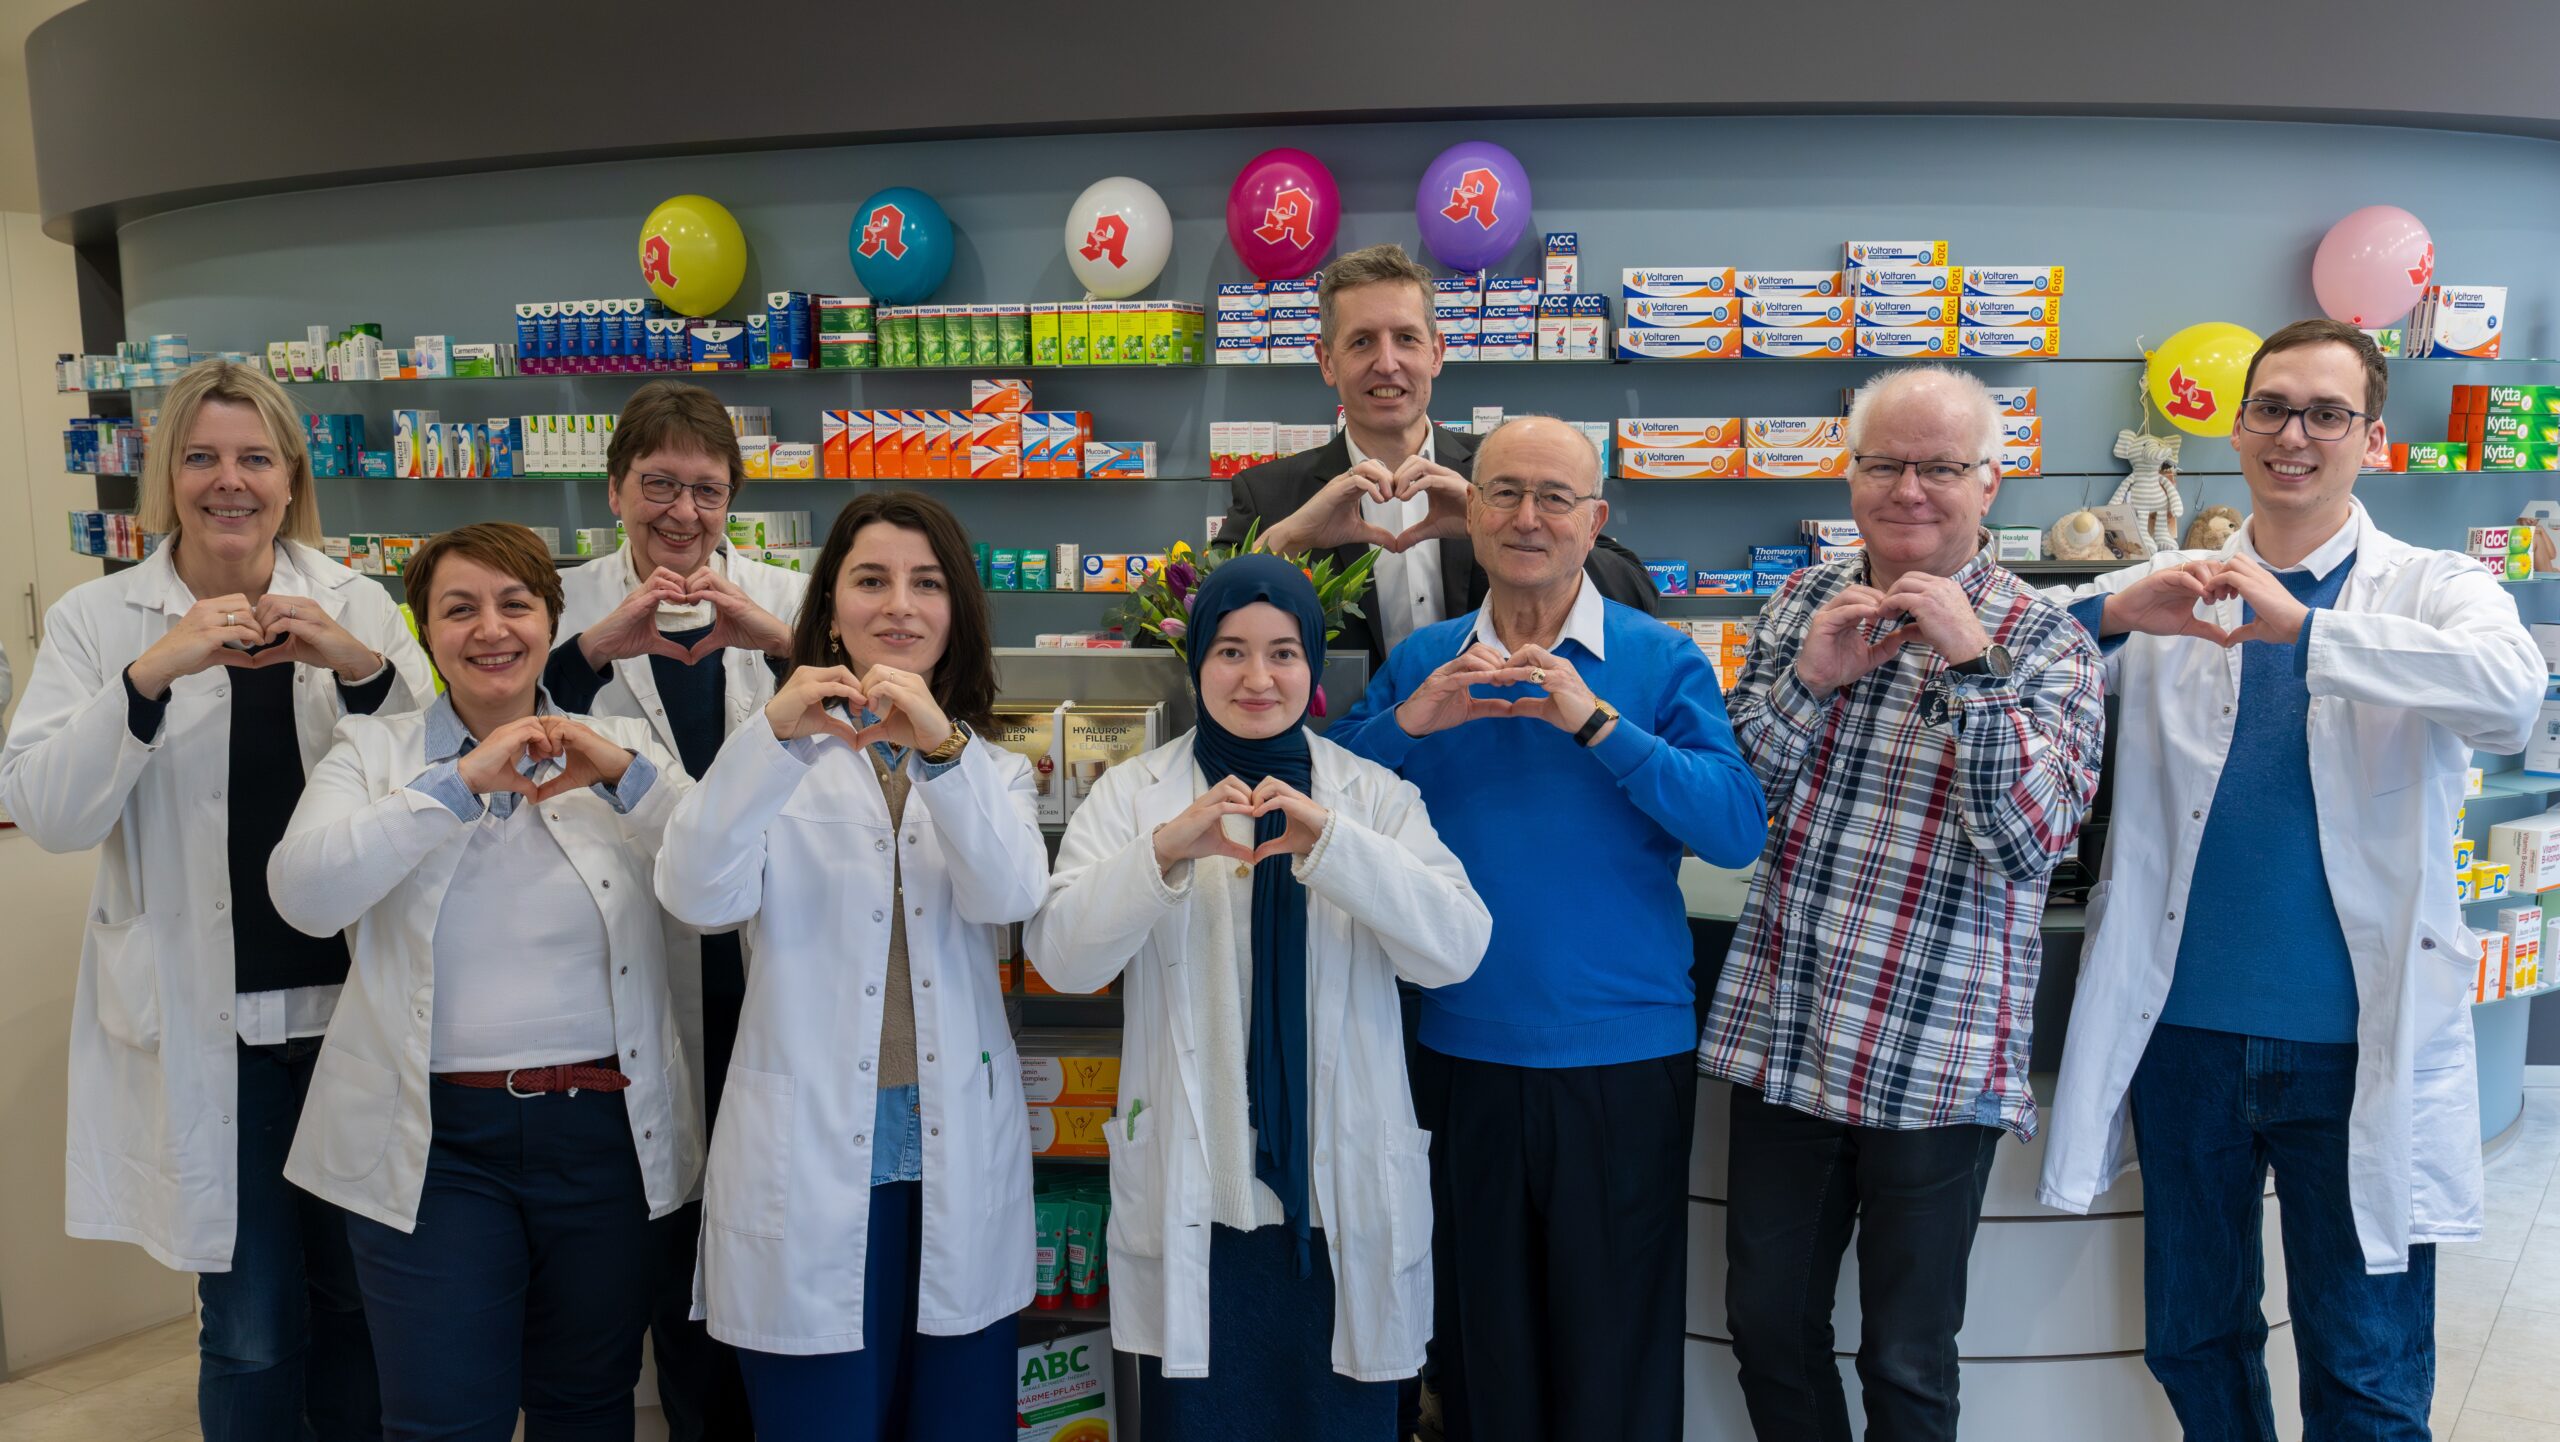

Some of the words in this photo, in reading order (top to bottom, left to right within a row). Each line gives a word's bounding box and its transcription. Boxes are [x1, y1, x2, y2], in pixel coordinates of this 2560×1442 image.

[1548, 235, 1575, 247] ACC
[1866, 246, 1902, 255] Voltaren
[1646, 272, 1684, 282] Voltaren
[1758, 276, 1794, 285] Voltaren
[1880, 272, 1916, 280] Voltaren
[1982, 272, 2018, 280] Voltaren
[1221, 285, 1241, 294] ACC
[1272, 282, 1292, 291] ACC
[1489, 280, 1510, 290] ACC
[2454, 291, 2483, 302] Voltaren
[1540, 296, 1568, 308] ACC
[1573, 296, 1600, 308] ACC
[1766, 302, 1802, 311] Voltaren
[1875, 302, 1911, 311] Voltaren
[1978, 302, 2014, 311] Voltaren
[1650, 302, 1688, 312] Voltaren
[1220, 312, 1240, 320] ACC
[1274, 310, 1294, 318] ACC
[1485, 308, 1506, 316] ACC
[1274, 336, 1294, 346] ACC
[1484, 335, 1504, 344] ACC
[1642, 332, 1680, 342] Voltaren
[1766, 332, 1803, 341] Voltaren
[1876, 332, 1912, 341] Voltaren
[1978, 332, 2014, 341] Voltaren
[1218, 338, 1238, 348] ACC
[2490, 388, 2521, 406] Kytta
[1642, 422, 1678, 432] Voltaren
[1769, 420, 1806, 428] Voltaren
[2487, 416, 2517, 435] Kytta
[1648, 453, 1685, 462] Voltaren
[1766, 453, 1804, 461] Voltaren
[2410, 446, 2438, 464] Kytta
[2484, 445, 2515, 463] Kytta
[2486, 530, 2508, 547] doc
[1755, 548, 1807, 556] Thomapyrin
[1645, 564, 1685, 572] omapyrin
[1698, 572, 1751, 580] Thomapyrin
[1073, 726, 1130, 734] HYALURON-
[1086, 734, 1118, 742] FILLER
[1020, 1345, 1090, 1386] ABC
[1017, 1380, 1097, 1406] WÄRME-PFLASTER
